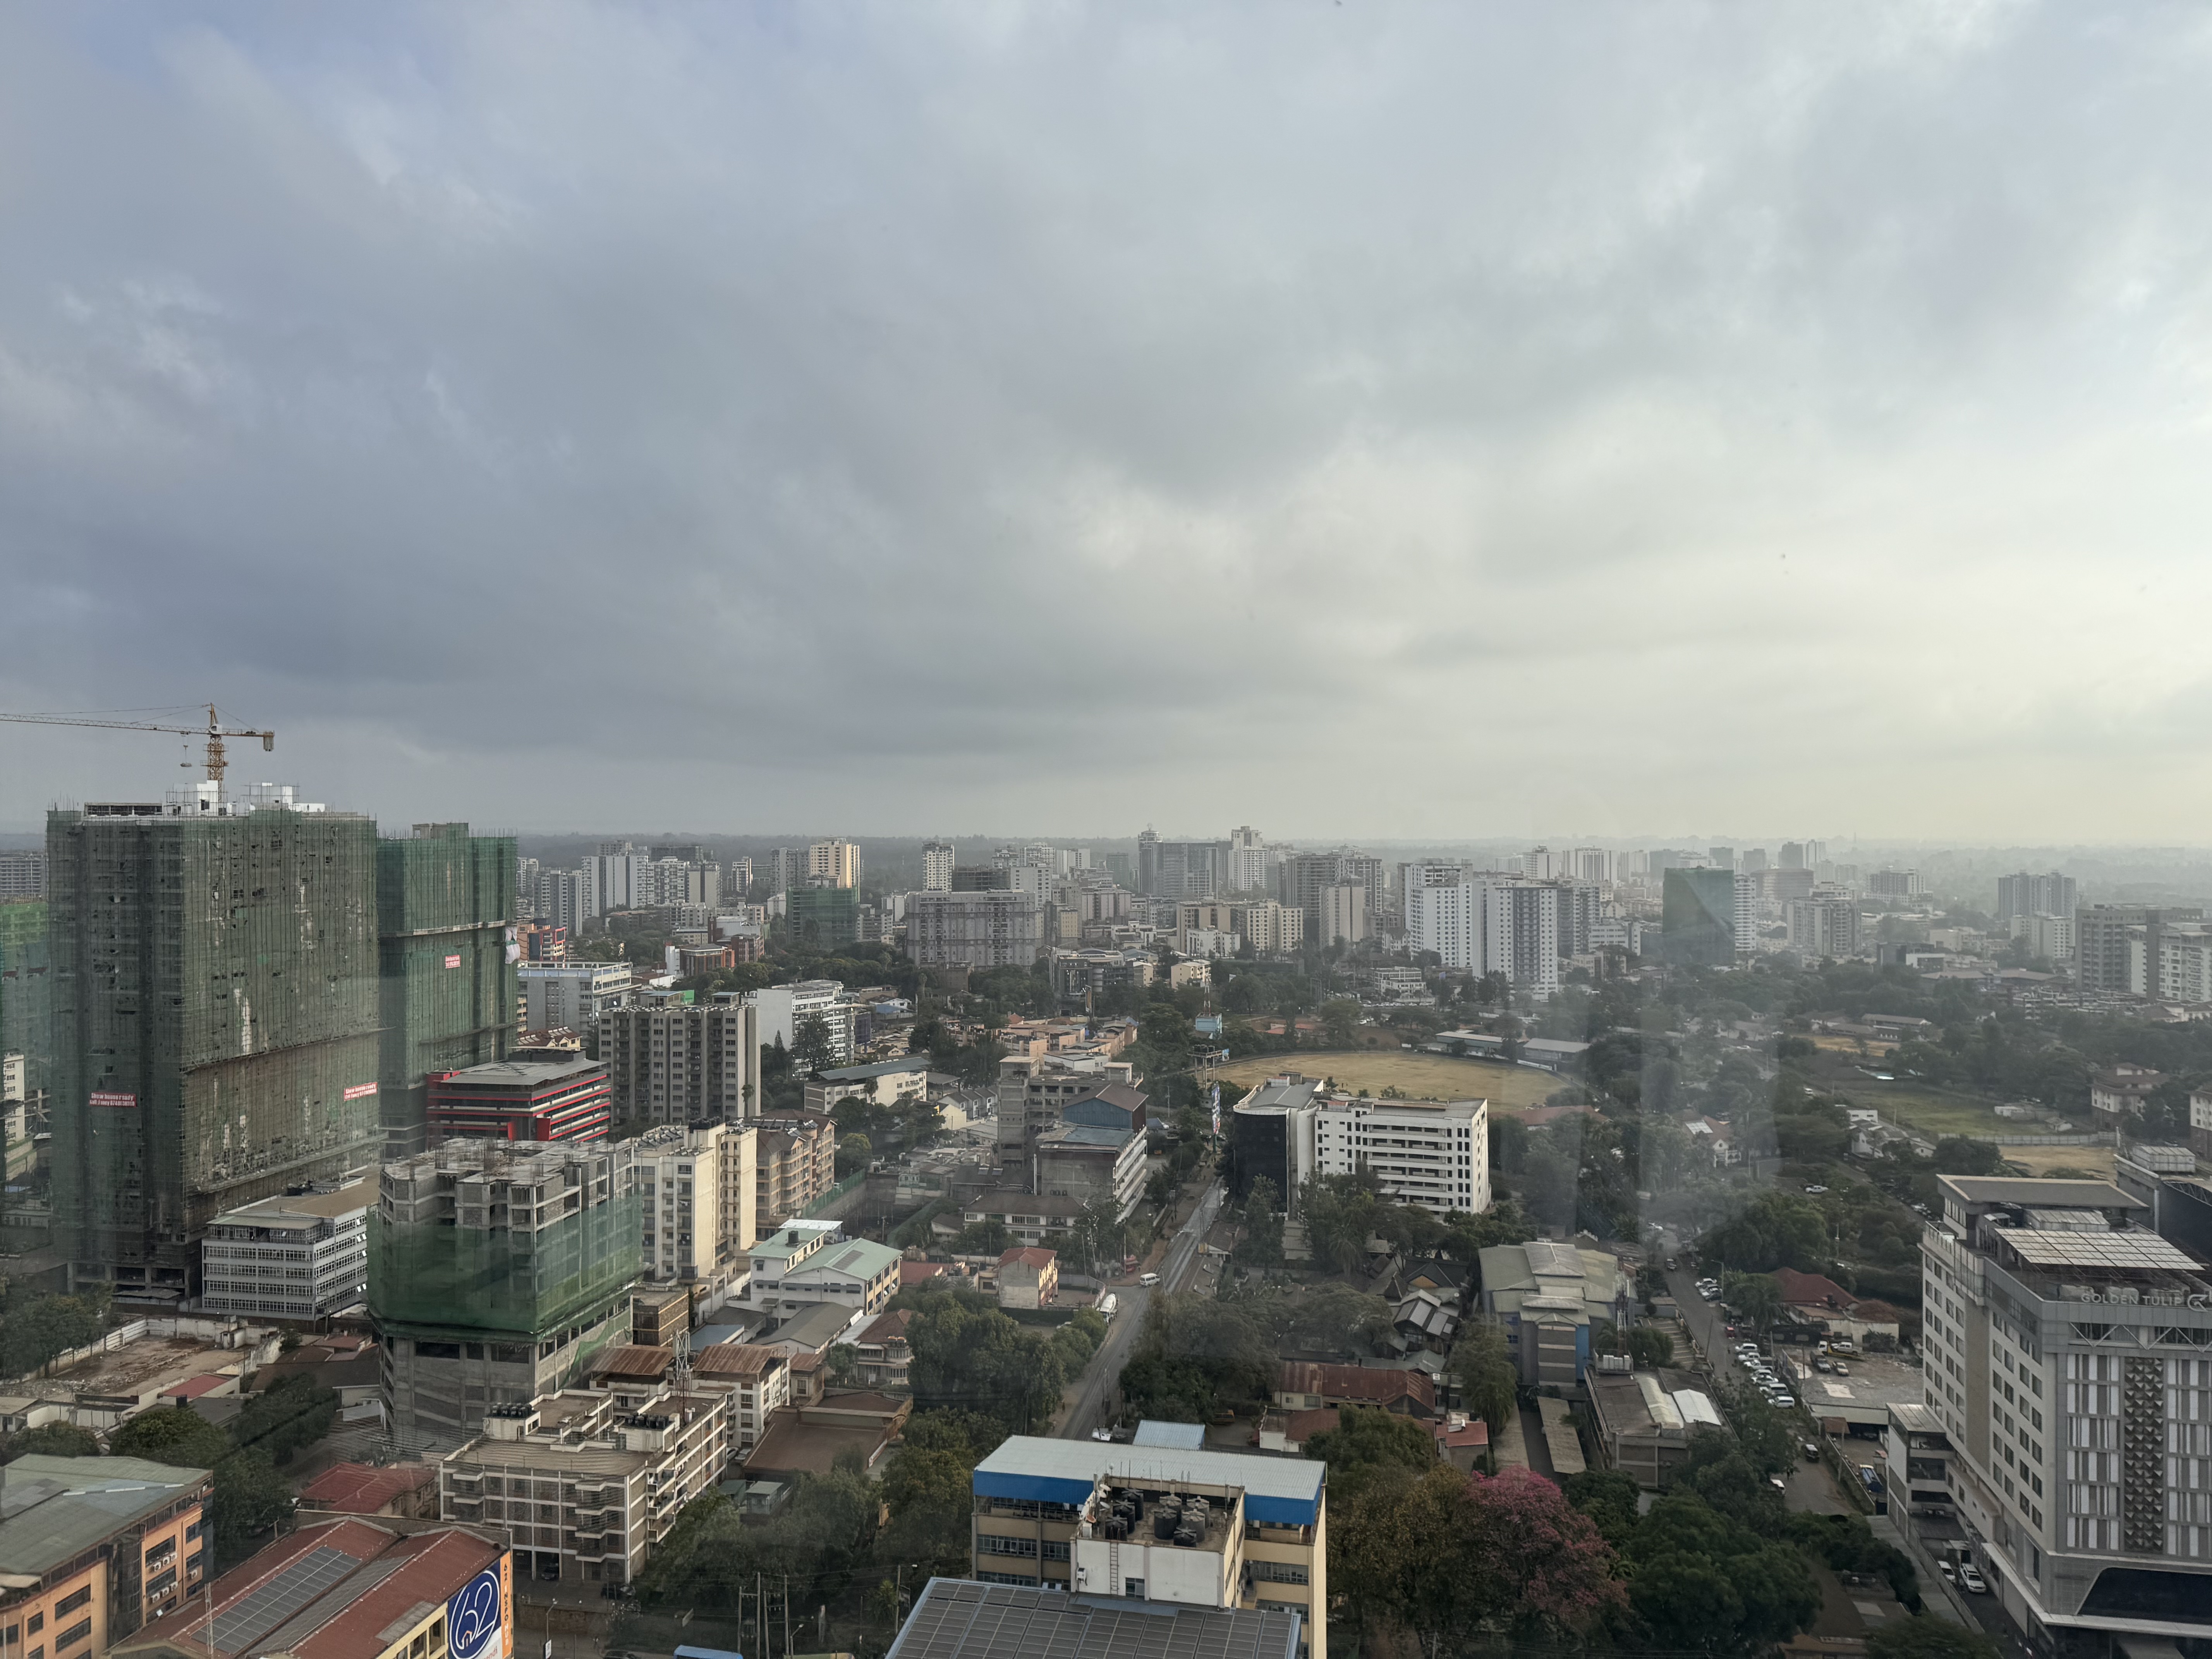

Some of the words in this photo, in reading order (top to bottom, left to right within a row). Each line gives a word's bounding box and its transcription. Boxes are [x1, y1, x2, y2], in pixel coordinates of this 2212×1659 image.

[2081, 1293, 2138, 1305] GOLDEN
[2142, 1295, 2182, 1306] TULIP
[504, 1563, 507, 1582] 62
[455, 1582, 495, 1650] 62
